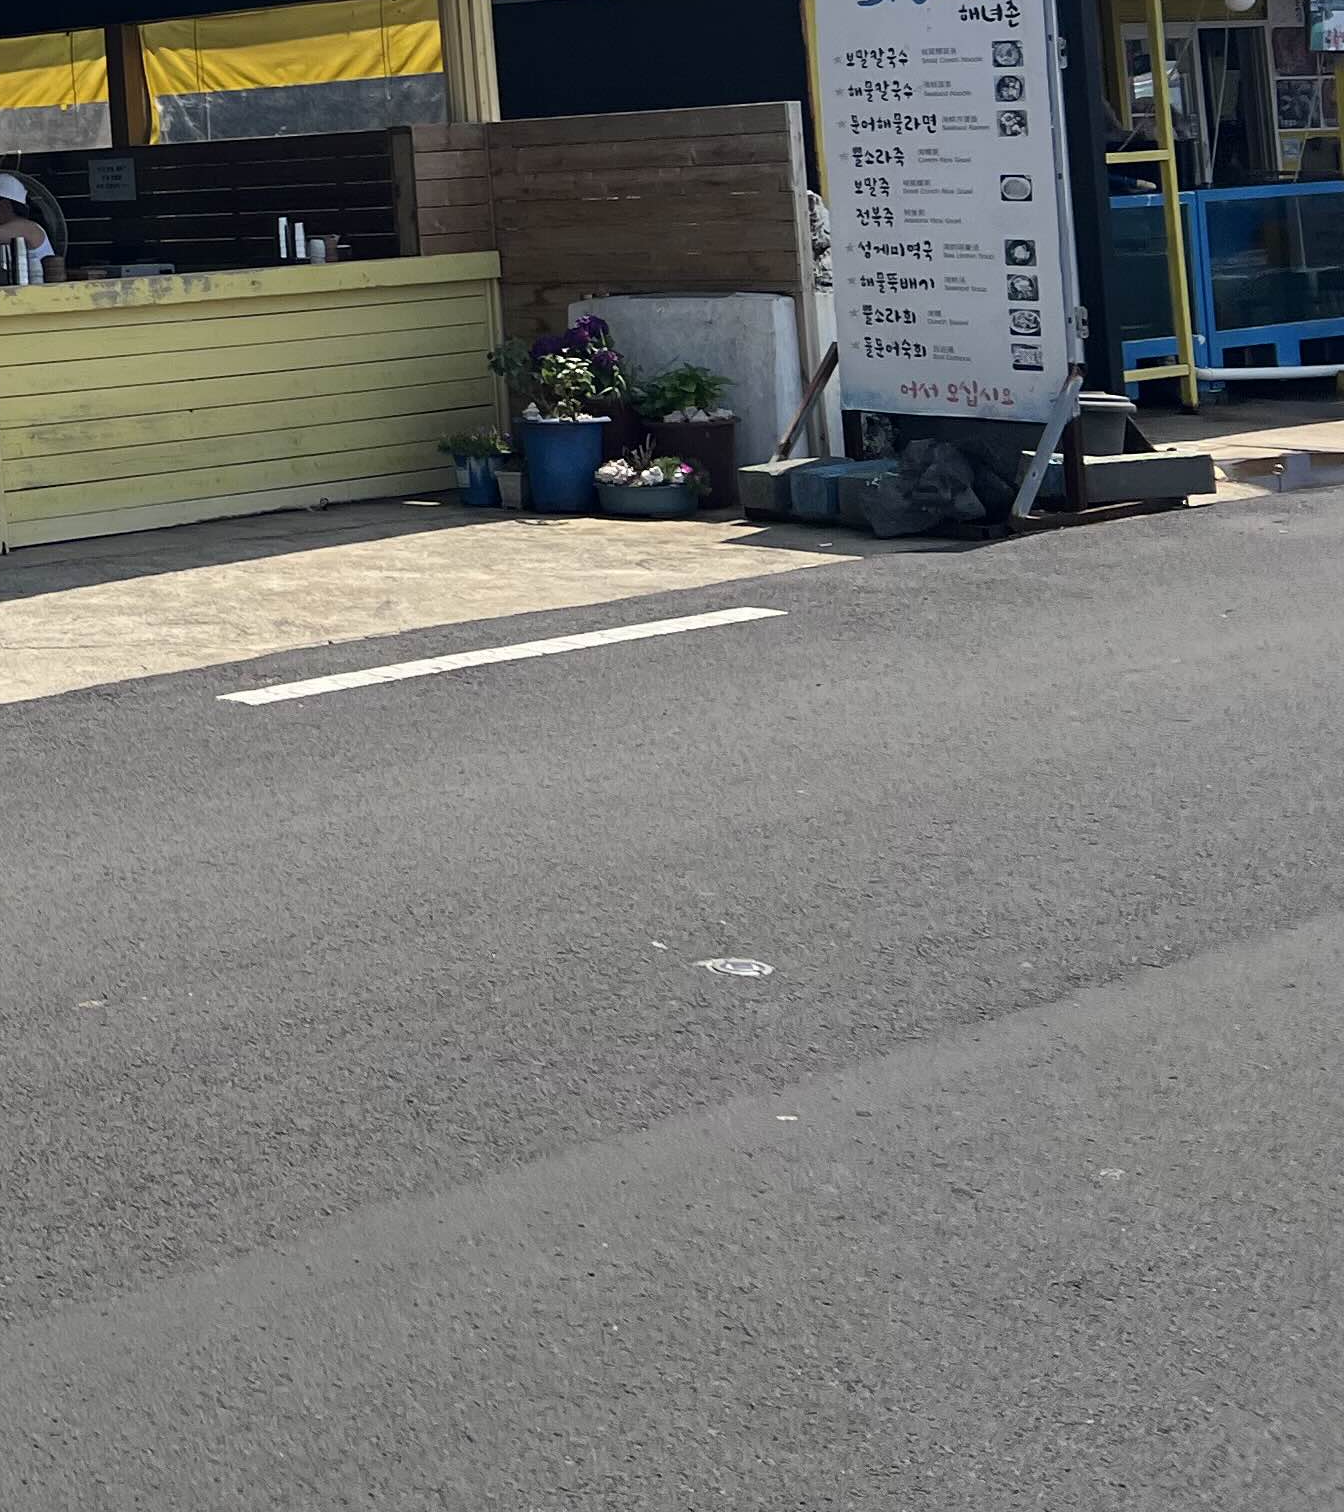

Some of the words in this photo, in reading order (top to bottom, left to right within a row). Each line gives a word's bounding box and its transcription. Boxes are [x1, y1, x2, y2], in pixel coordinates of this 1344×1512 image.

[846, 47, 909, 68] 보말칼국수
[848, 80, 913, 102] 해물칼국수
[850, 112, 937, 134] 문어해물라면
[854, 177, 890, 197] 보말죽
[856, 206, 894, 227] 전복죽
[857, 240, 933, 262] 성게미역국
[860, 271, 935, 294] 해물뚝배기
[900, 380, 939, 399] 어서
